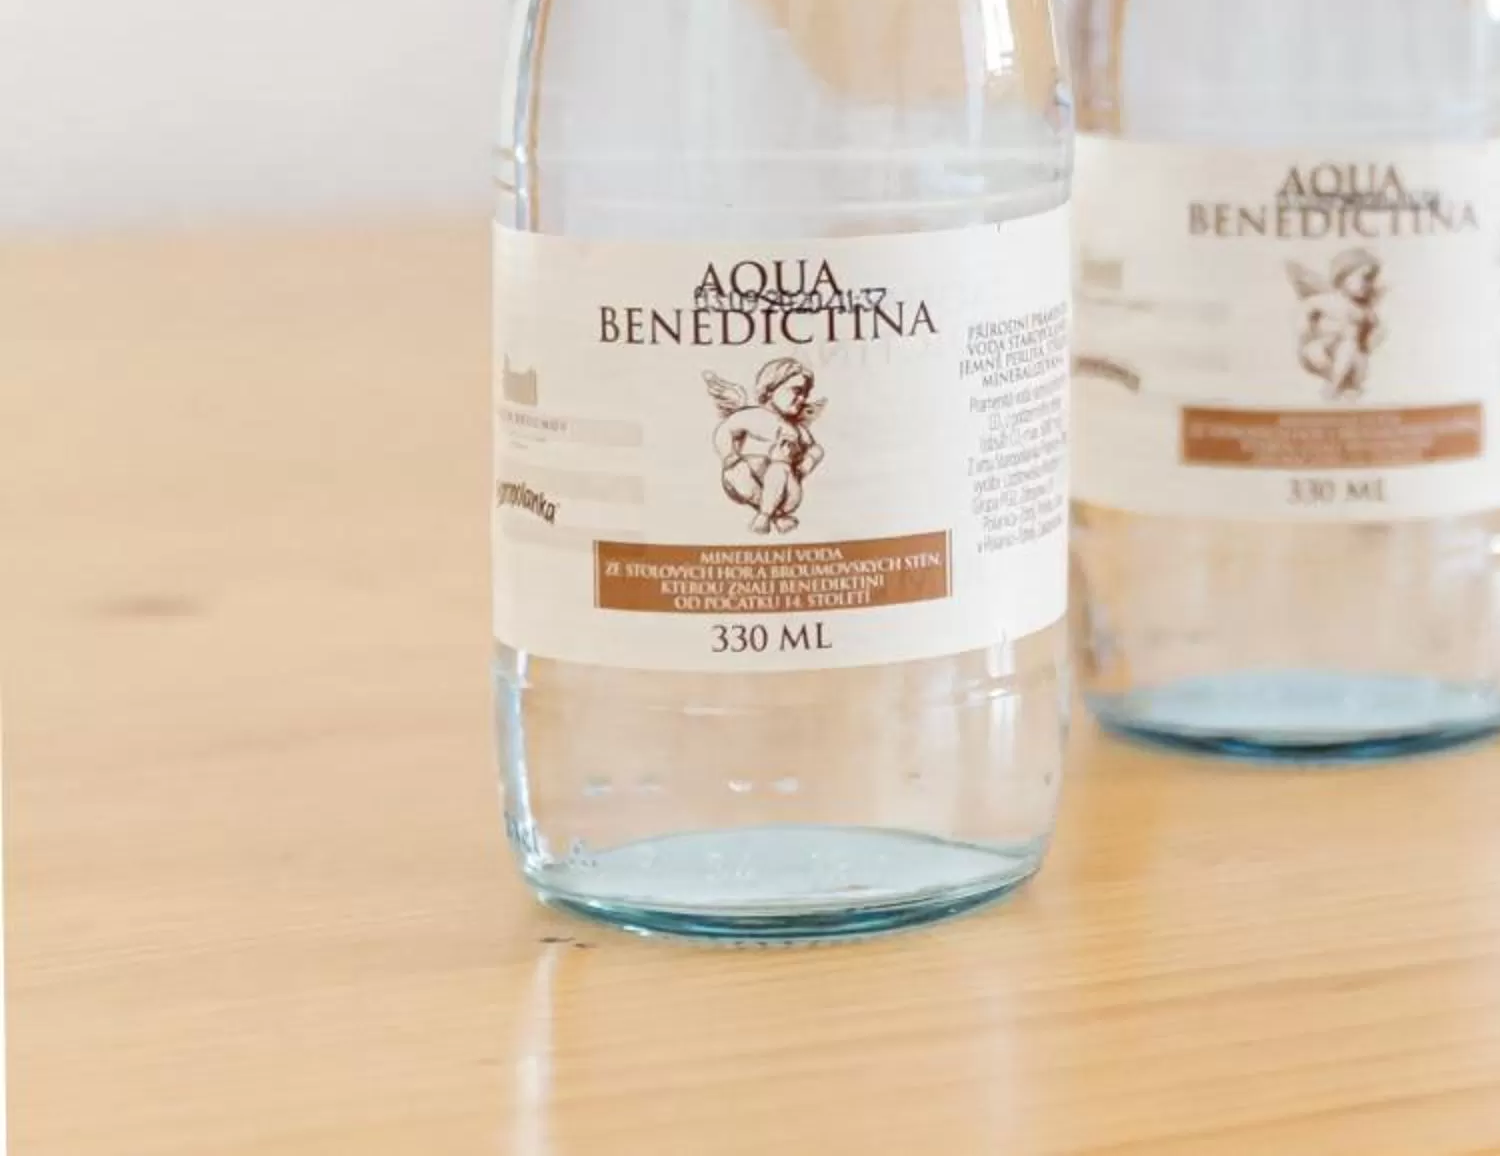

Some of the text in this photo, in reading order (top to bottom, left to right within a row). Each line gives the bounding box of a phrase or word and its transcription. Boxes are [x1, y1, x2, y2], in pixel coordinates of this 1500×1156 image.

[1277, 162, 1406, 199] AQUA
[1188, 200, 1480, 240] BENEDICTINA
[698, 258, 847, 305] AQUA
[599, 301, 940, 346] BENEDICTINA
[1344, 476, 1386, 502] ML
[795, 547, 845, 563] VODA
[661, 580, 724, 595] KTEROU
[779, 573, 885, 594] BENEDIKTINI
[717, 565, 754, 579] HOR
[755, 565, 767, 579] A
[674, 596, 701, 610] OD
[711, 621, 833, 653] 330 ML
